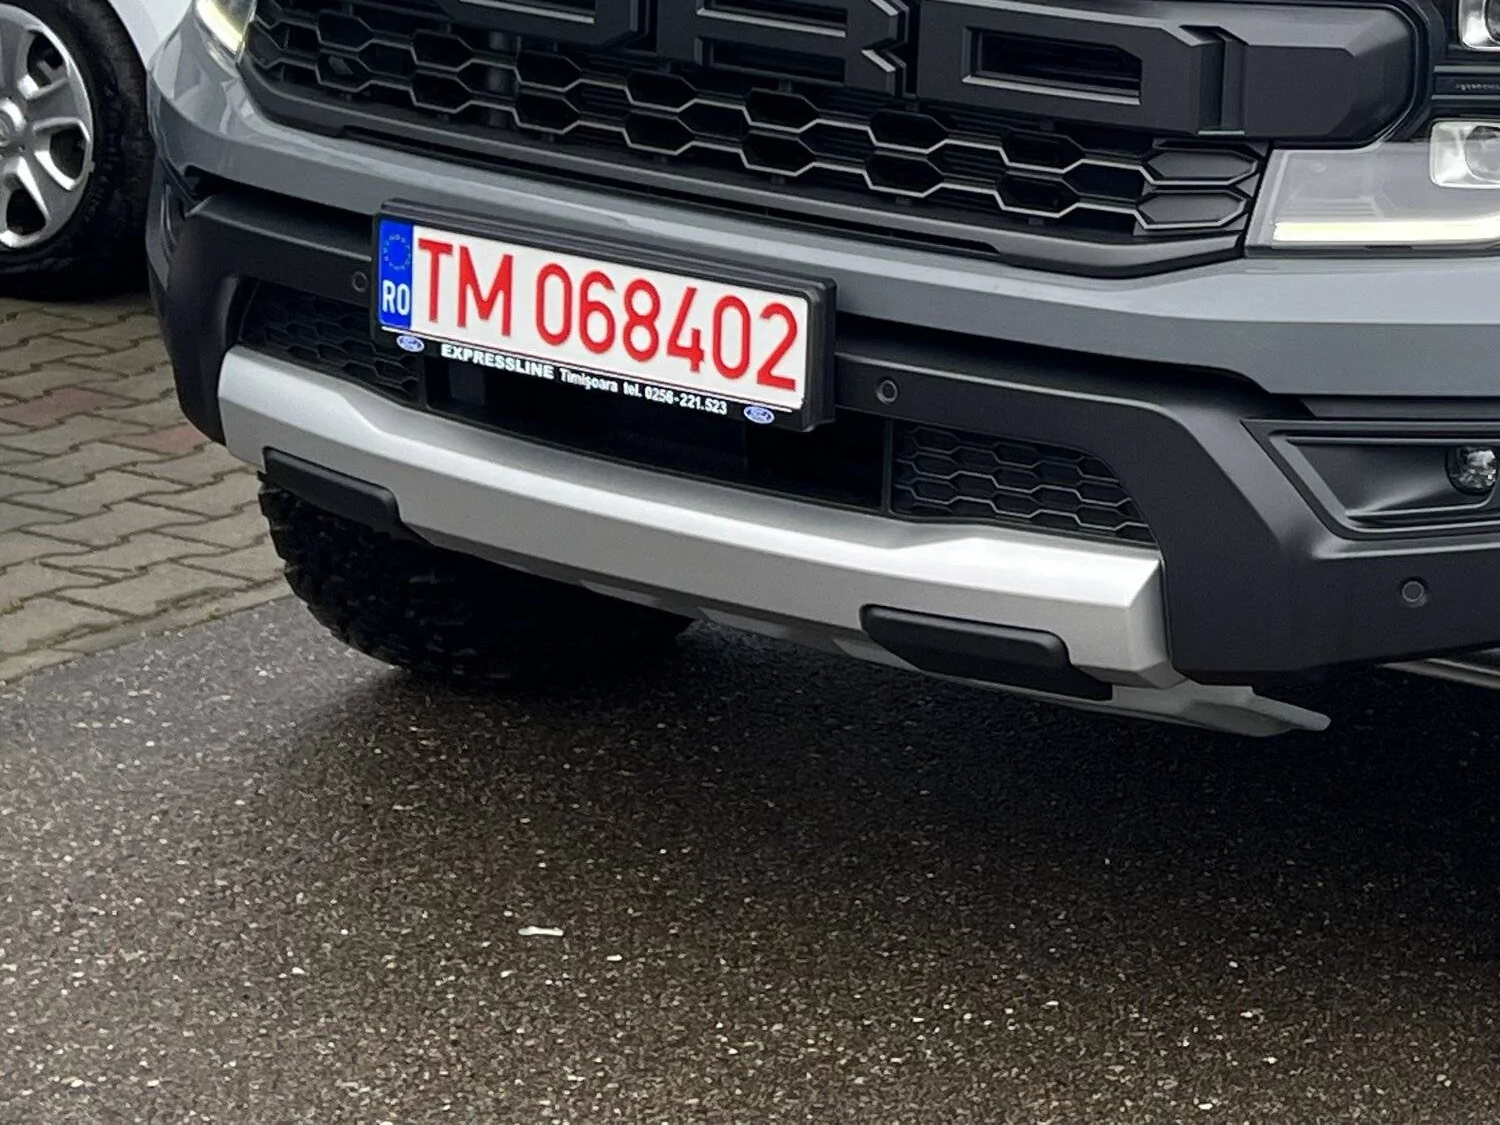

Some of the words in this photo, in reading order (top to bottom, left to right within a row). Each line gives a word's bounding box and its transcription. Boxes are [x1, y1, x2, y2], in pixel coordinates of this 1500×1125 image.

[382, 279, 411, 317] RO
[417, 236, 514, 337] TM
[535, 262, 798, 392] 068402
[440, 344, 555, 380] EXPRESSLINE
